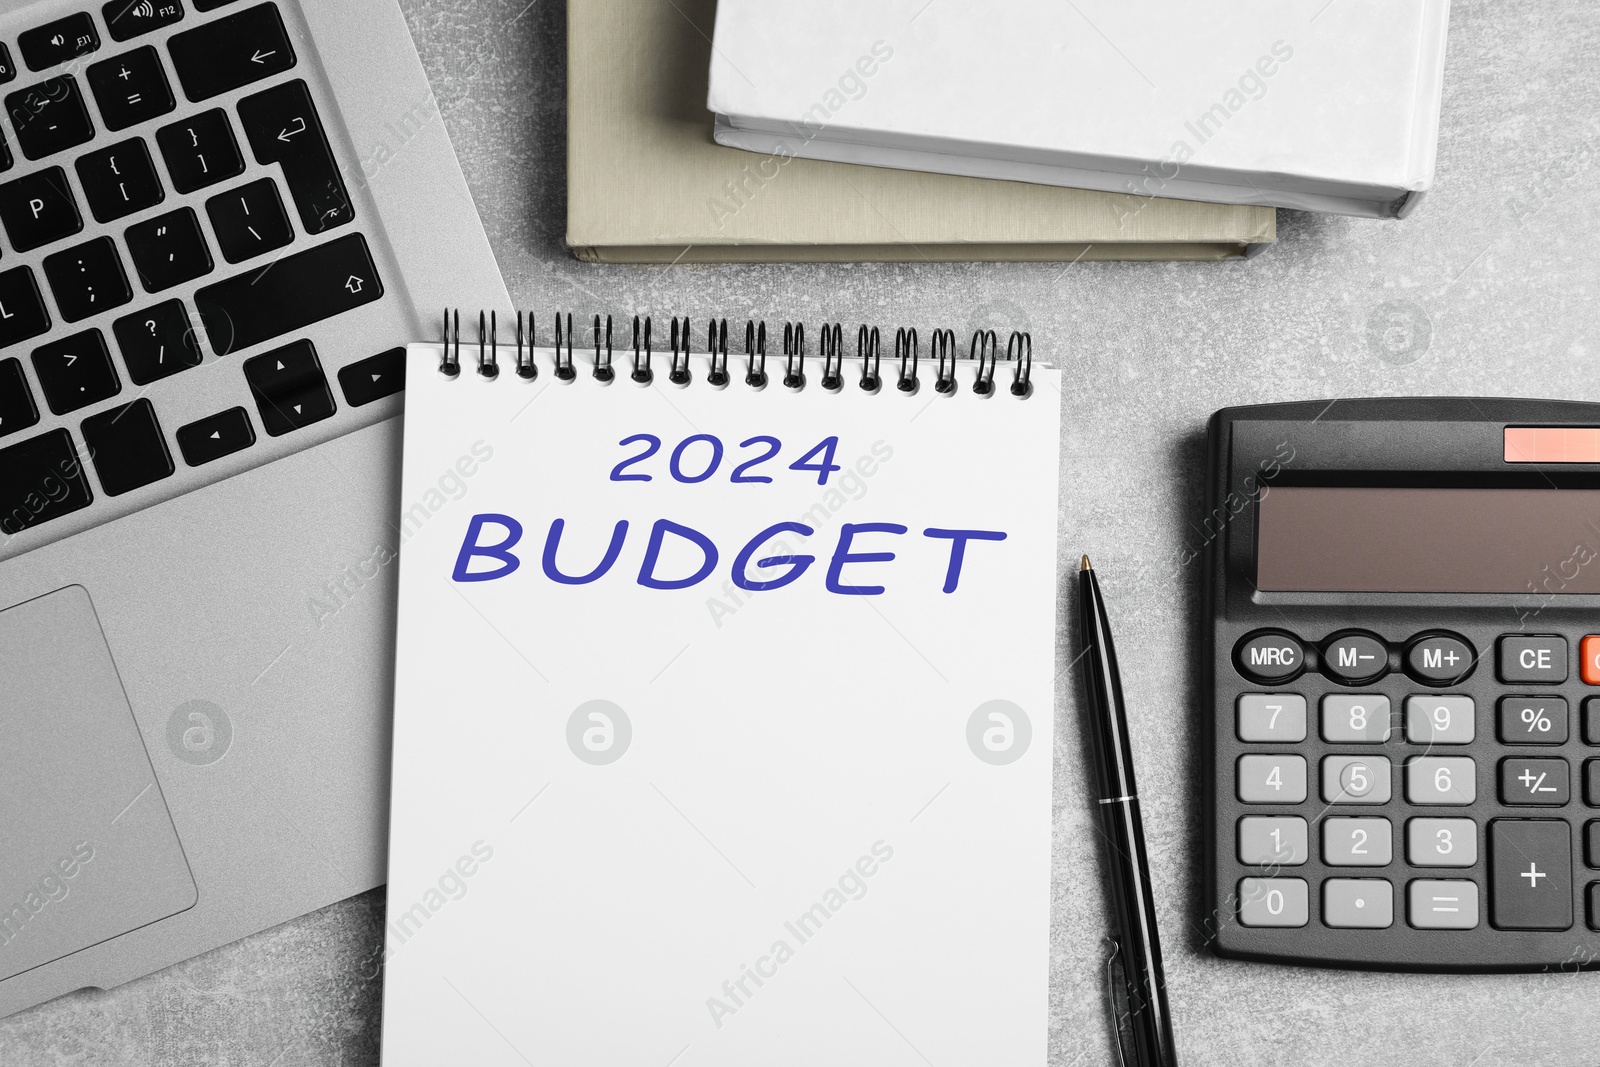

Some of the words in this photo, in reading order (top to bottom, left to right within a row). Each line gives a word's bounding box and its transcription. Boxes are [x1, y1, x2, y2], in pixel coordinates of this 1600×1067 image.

[159, 5, 176, 18] F12
[76, 34, 92, 47] F11
[118, 67, 131, 80] +
[127, 93, 142, 104] =
[187, 128, 198, 147] }
[109, 156, 120, 175] {
[197, 154, 208, 173] ]
[119, 182, 130, 201] [
[29, 198, 44, 219] P
[247, 226, 262, 241] \
[78, 260, 86, 272] :
[87, 286, 95, 302] ;
[145, 319, 156, 337] ?
[63, 354, 78, 367] >
[159, 345, 164, 364] /
[610, 434, 840, 485] 2024
[452, 513, 1008, 596] BUDGET
[1251, 647, 1294, 666] MRC
[1423, 648, 1460, 668] M+
[1519, 648, 1552, 669] CE
[1265, 705, 1283, 730] 7
[1349, 705, 1367, 731] 8
[1433, 706, 1451, 732] 9
[1520, 708, 1552, 733] %
[1265, 766, 1283, 791] 4
[1349, 766, 1368, 792] 5
[1434, 767, 1452, 793] 6
[1269, 828, 1281, 853] 1
[1351, 829, 1368, 854] 2
[1435, 829, 1453, 855] 3
[1520, 862, 1547, 888] +
[1267, 889, 1284, 915] 0
[1432, 896, 1459, 912] =
